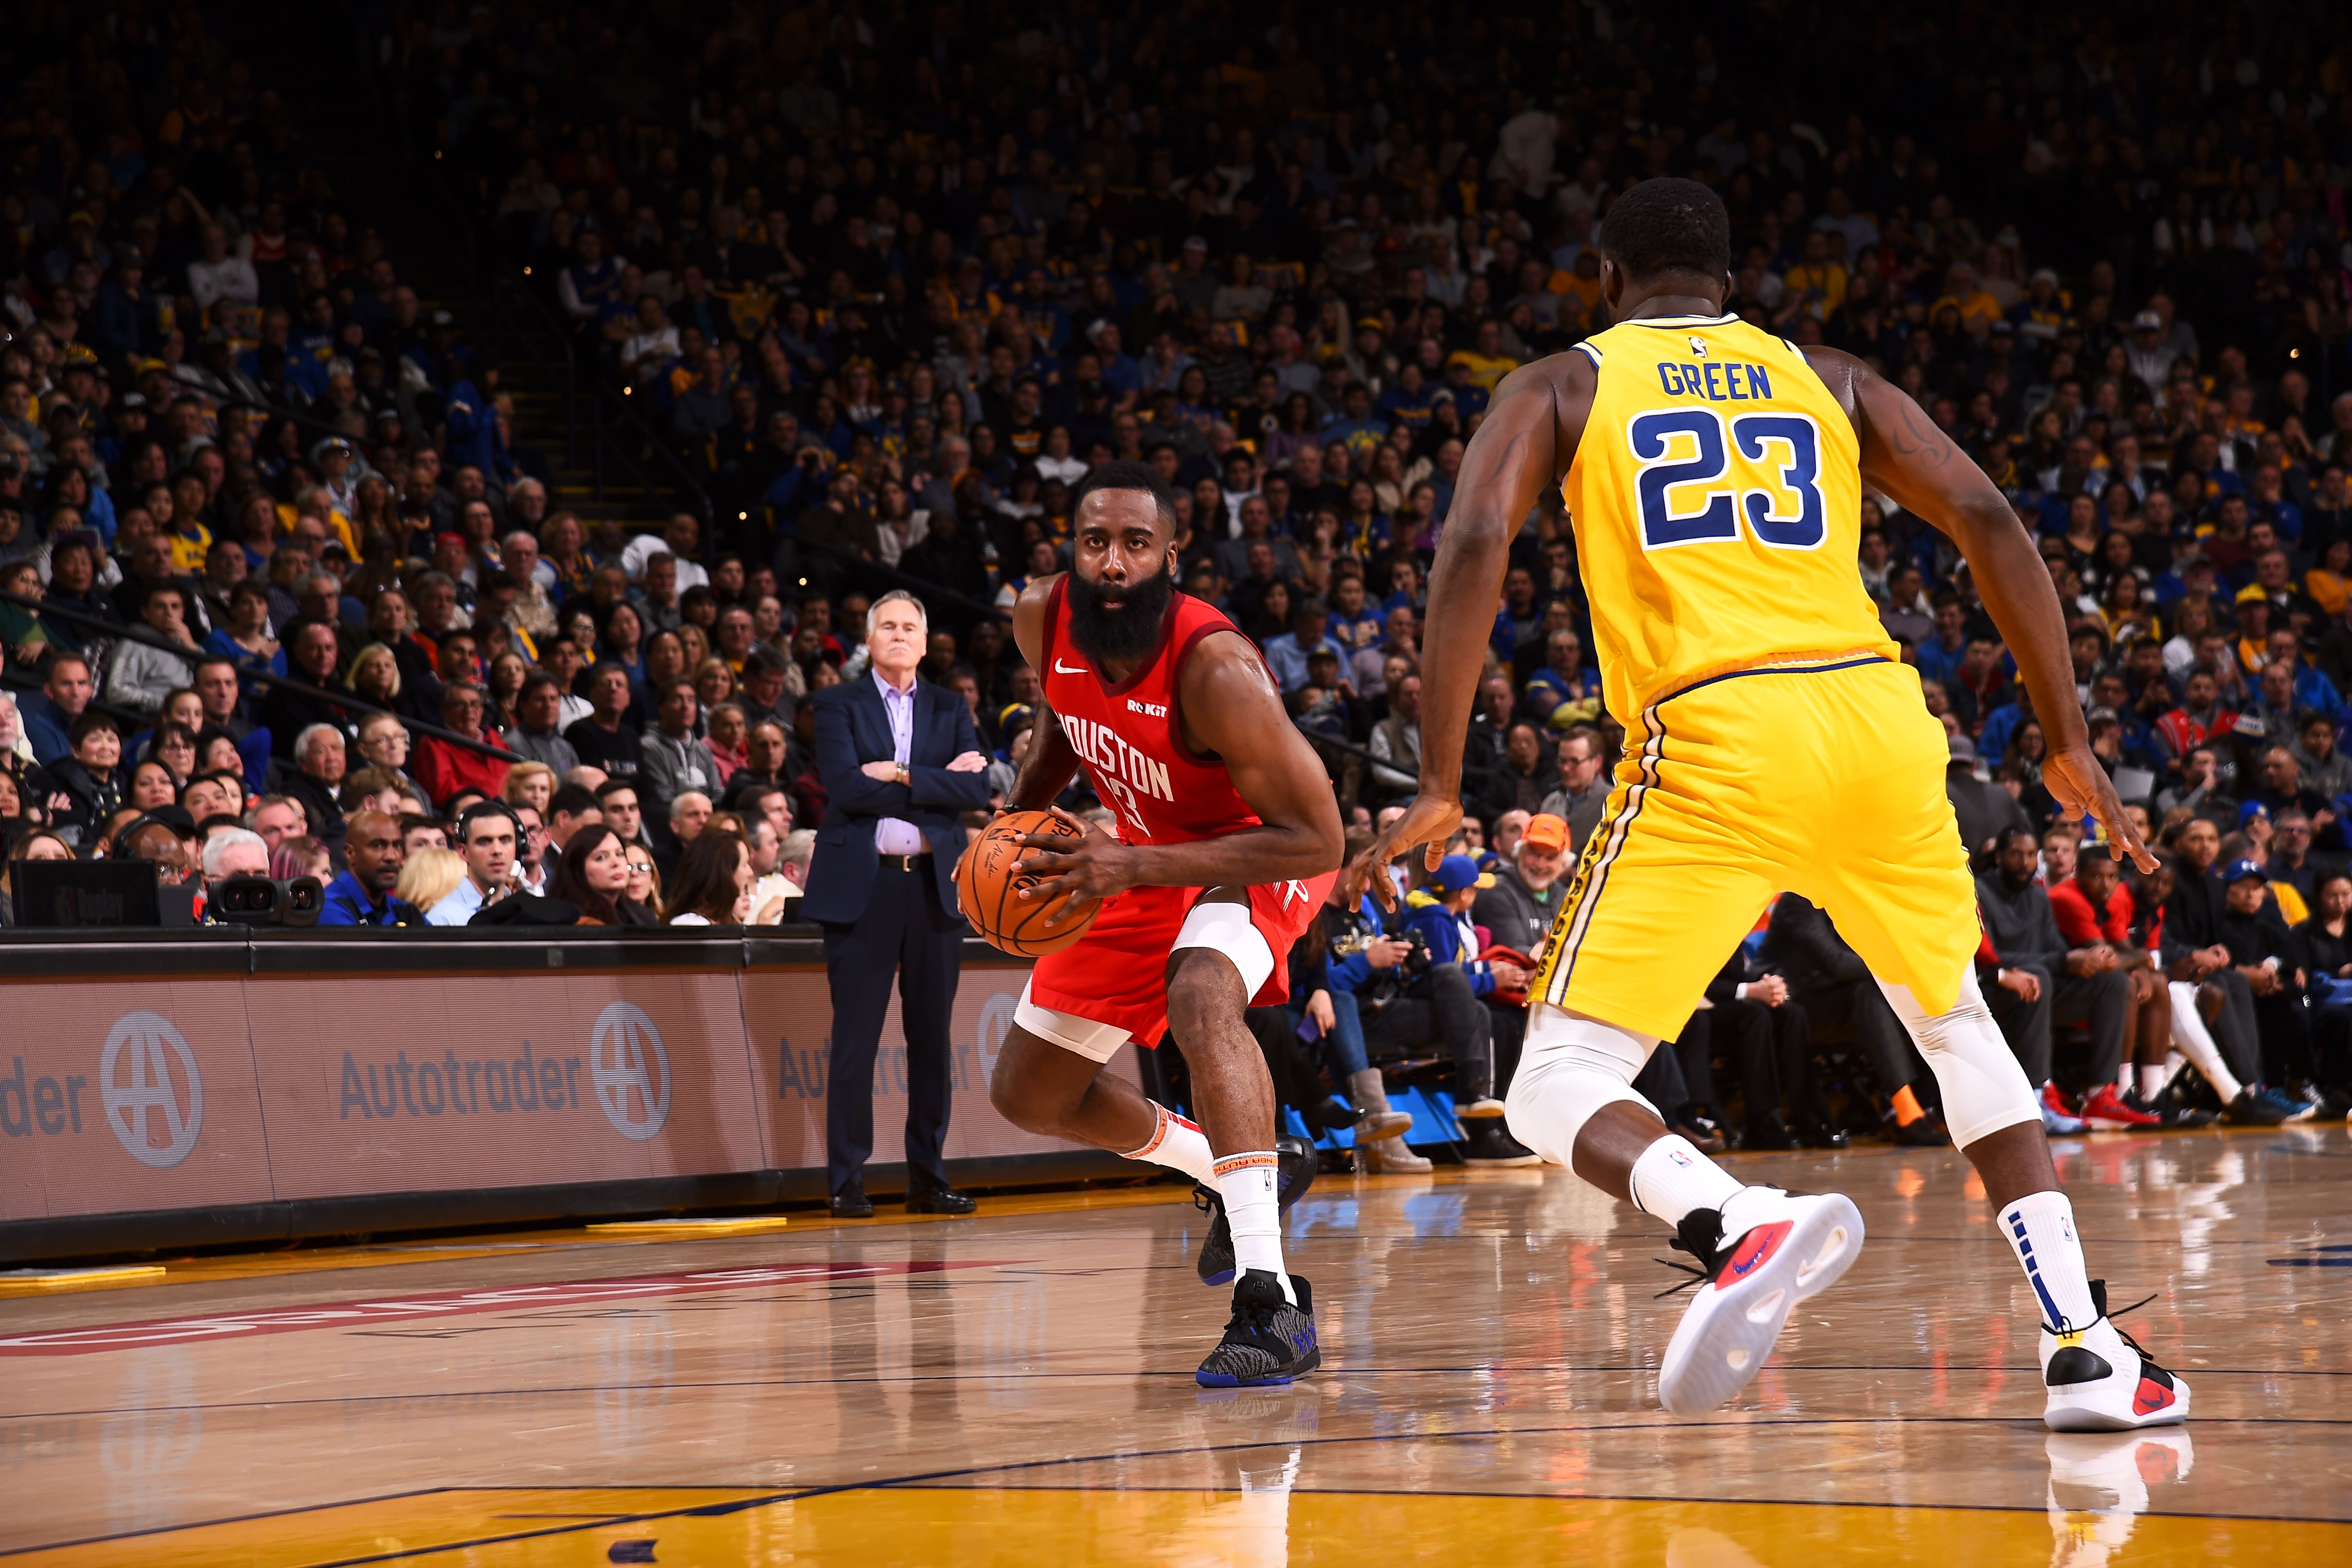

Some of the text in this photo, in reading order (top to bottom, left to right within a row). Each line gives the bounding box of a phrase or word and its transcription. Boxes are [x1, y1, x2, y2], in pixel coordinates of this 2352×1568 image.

[1657, 362, 1772, 400] GREEN
[1627, 406, 1828, 551] 23
[341, 1040, 581, 1119] Autotrader
